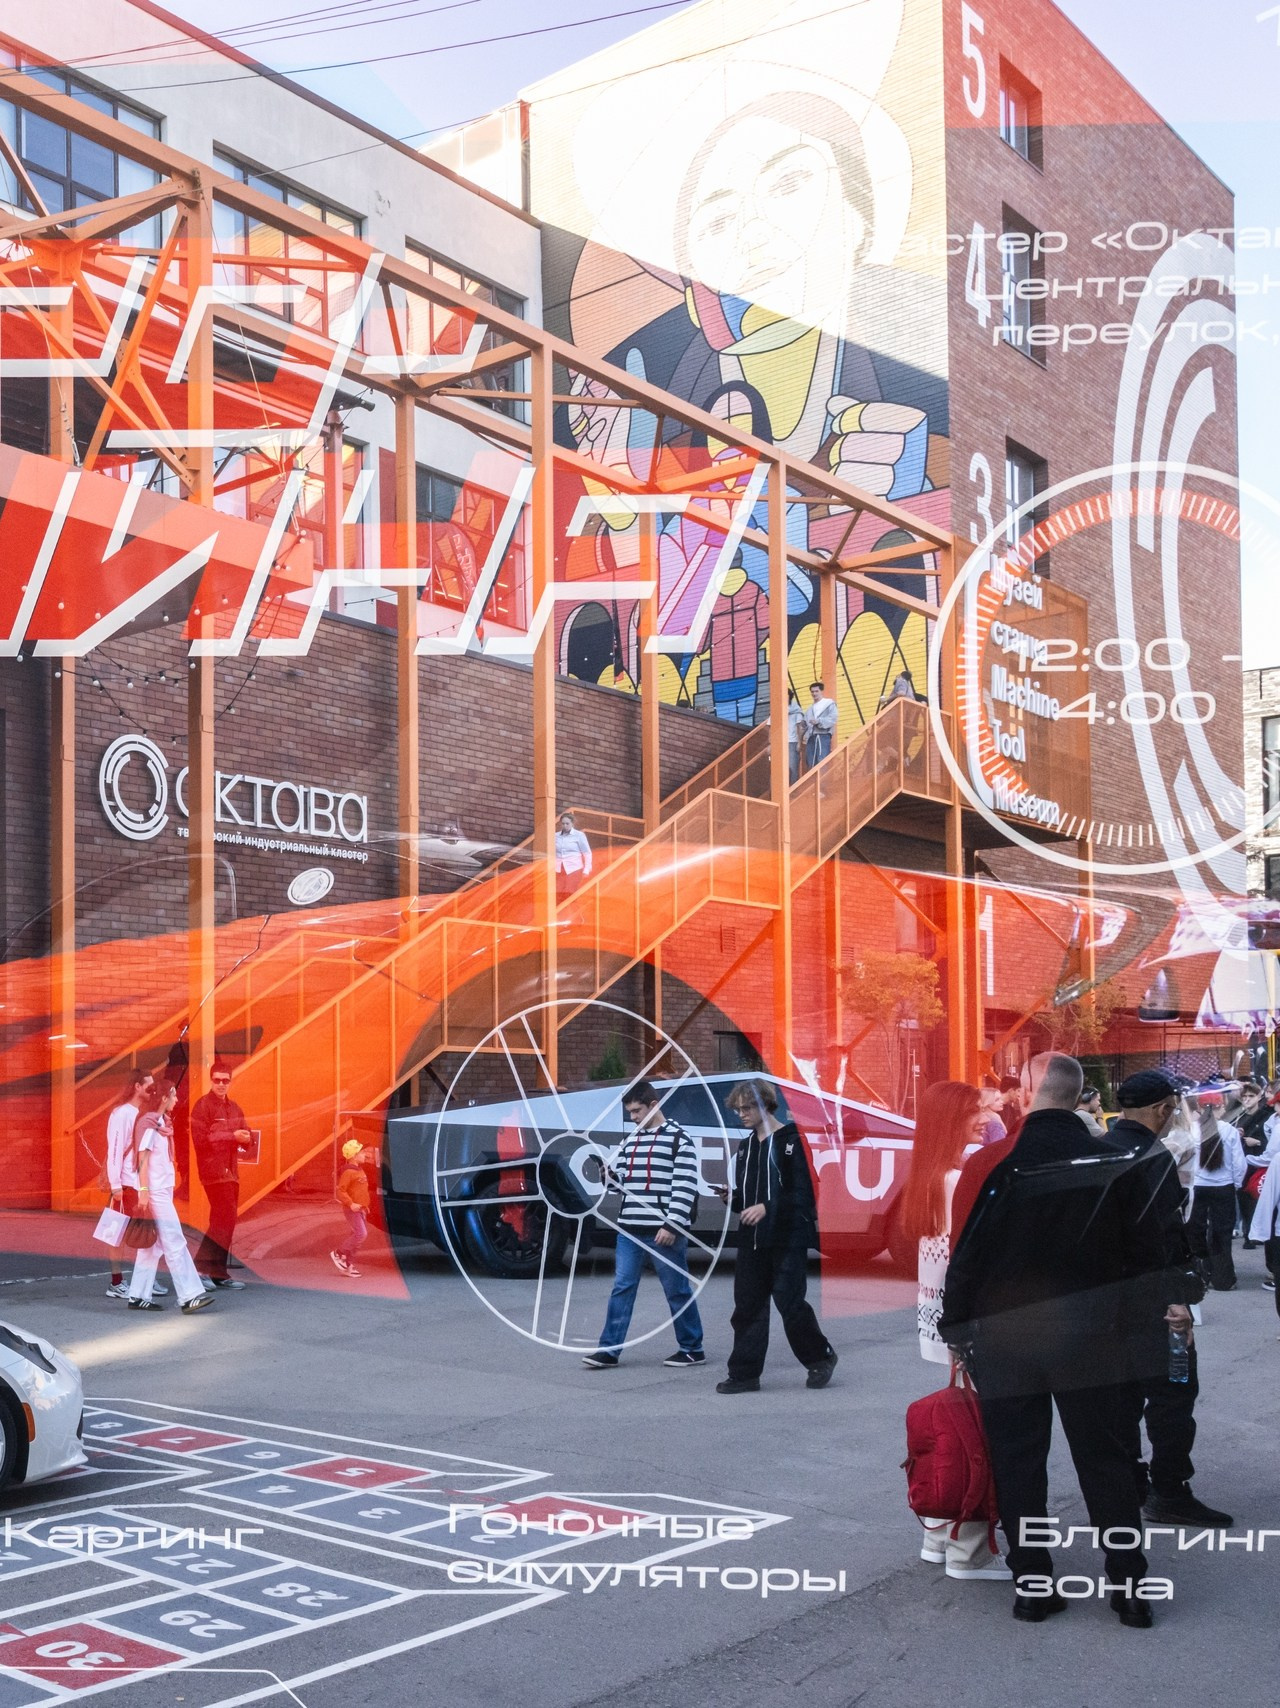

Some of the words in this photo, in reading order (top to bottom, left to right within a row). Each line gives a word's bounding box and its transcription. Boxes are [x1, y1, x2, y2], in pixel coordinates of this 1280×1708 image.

[962, 2, 986, 118] 5
[965, 221, 991, 328] 4
[969, 451, 994, 545] 3
[990, 552, 1044, 612] Музей
[990, 618, 1049, 666] станка
[991, 664, 1062, 722] Machine
[992, 716, 1027, 764] Tool
[992, 774, 1062, 827] Museum
[177, 825, 243, 847] твеский
[244, 834, 329, 857] индустриальный
[330, 844, 369, 864] кластер
[89, 1421, 124, 1430] 8
[163, 1436, 197, 1445] 7
[257, 1484, 297, 1495] 4
[334, 1466, 377, 1478] 5
[357, 1507, 402, 1519] 3
[152, 1551, 236, 1575] 27
[261, 1581, 349, 1607] 28
[159, 1609, 246, 1638] 29
[35, 1640, 125, 1671] 30
